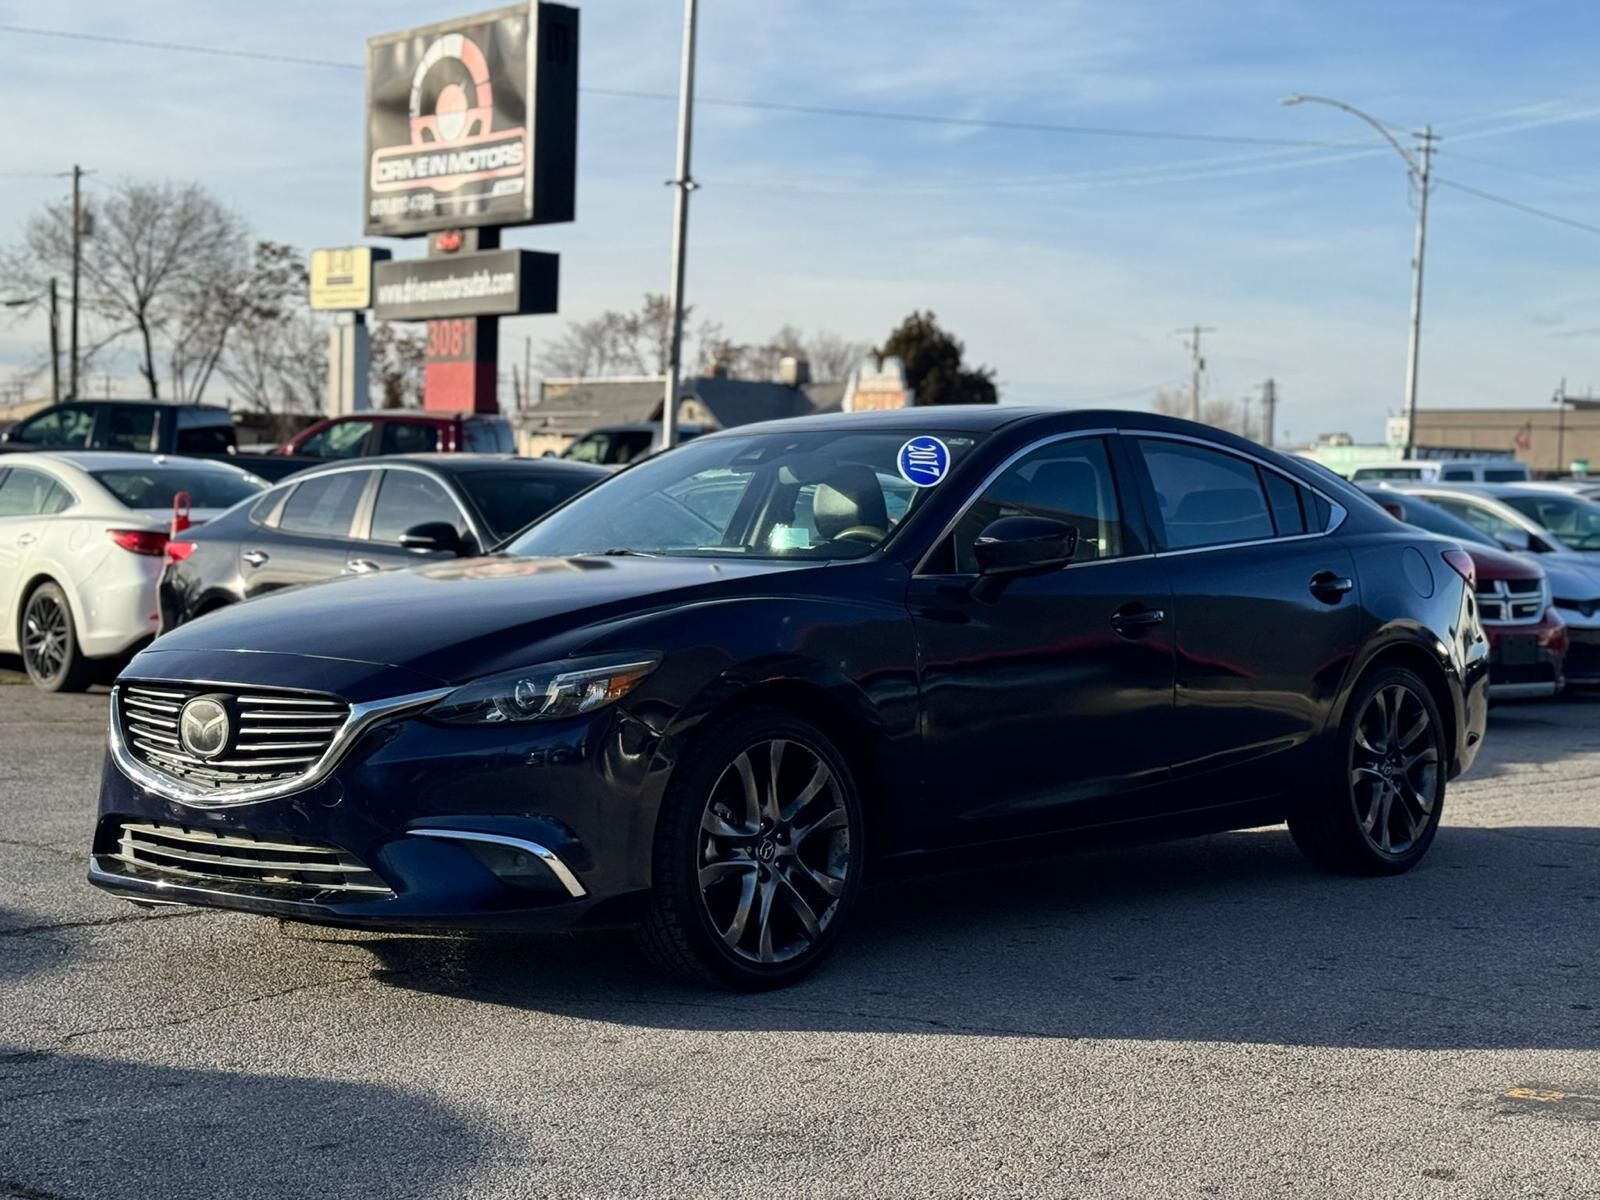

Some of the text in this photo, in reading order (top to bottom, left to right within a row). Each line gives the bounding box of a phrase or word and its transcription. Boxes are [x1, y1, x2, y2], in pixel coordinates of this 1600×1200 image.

[379, 142, 524, 181] DRIVE IN MOTORS
[426, 319, 474, 357] 3081
[907, 444, 940, 477] 2017
